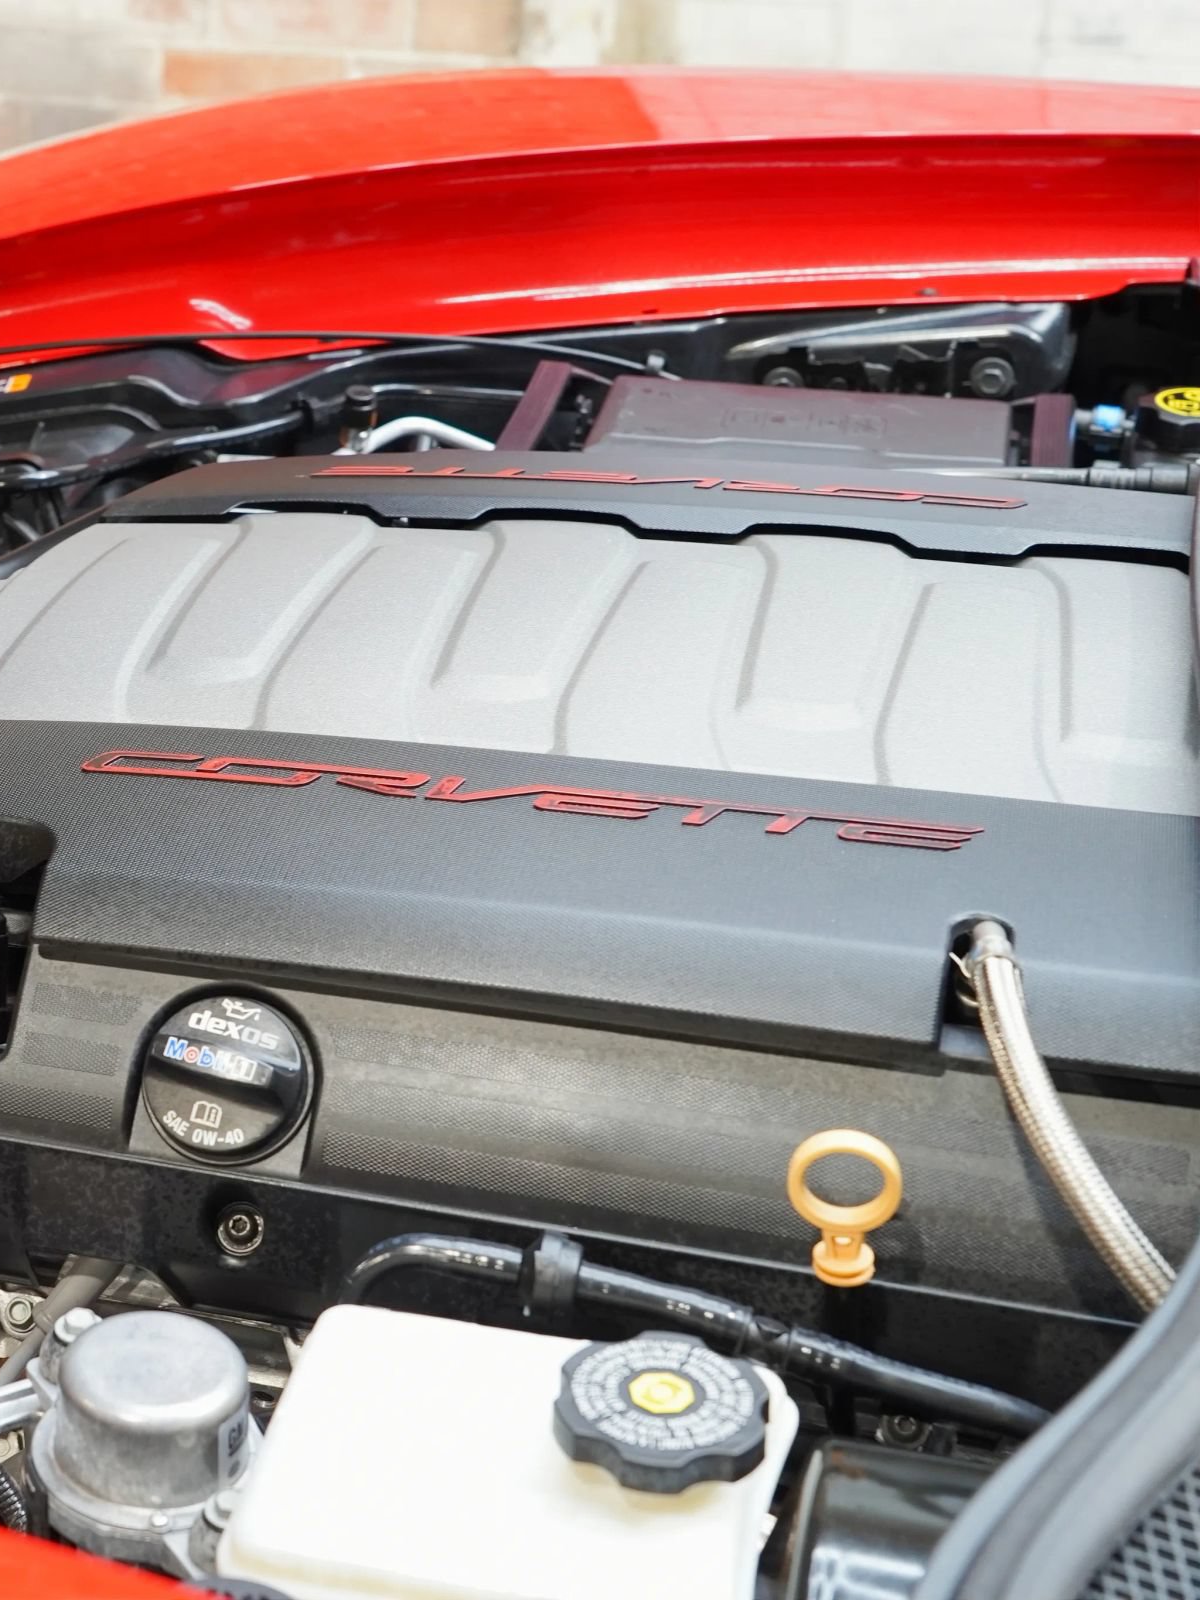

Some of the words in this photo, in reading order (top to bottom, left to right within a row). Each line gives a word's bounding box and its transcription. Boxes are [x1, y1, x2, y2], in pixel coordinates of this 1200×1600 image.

[81, 749, 984, 851] CORVETTE
[188, 1011, 279, 1050] dexos
[162, 1110, 190, 1137] SAE
[192, 1128, 244, 1146] 0W-40
